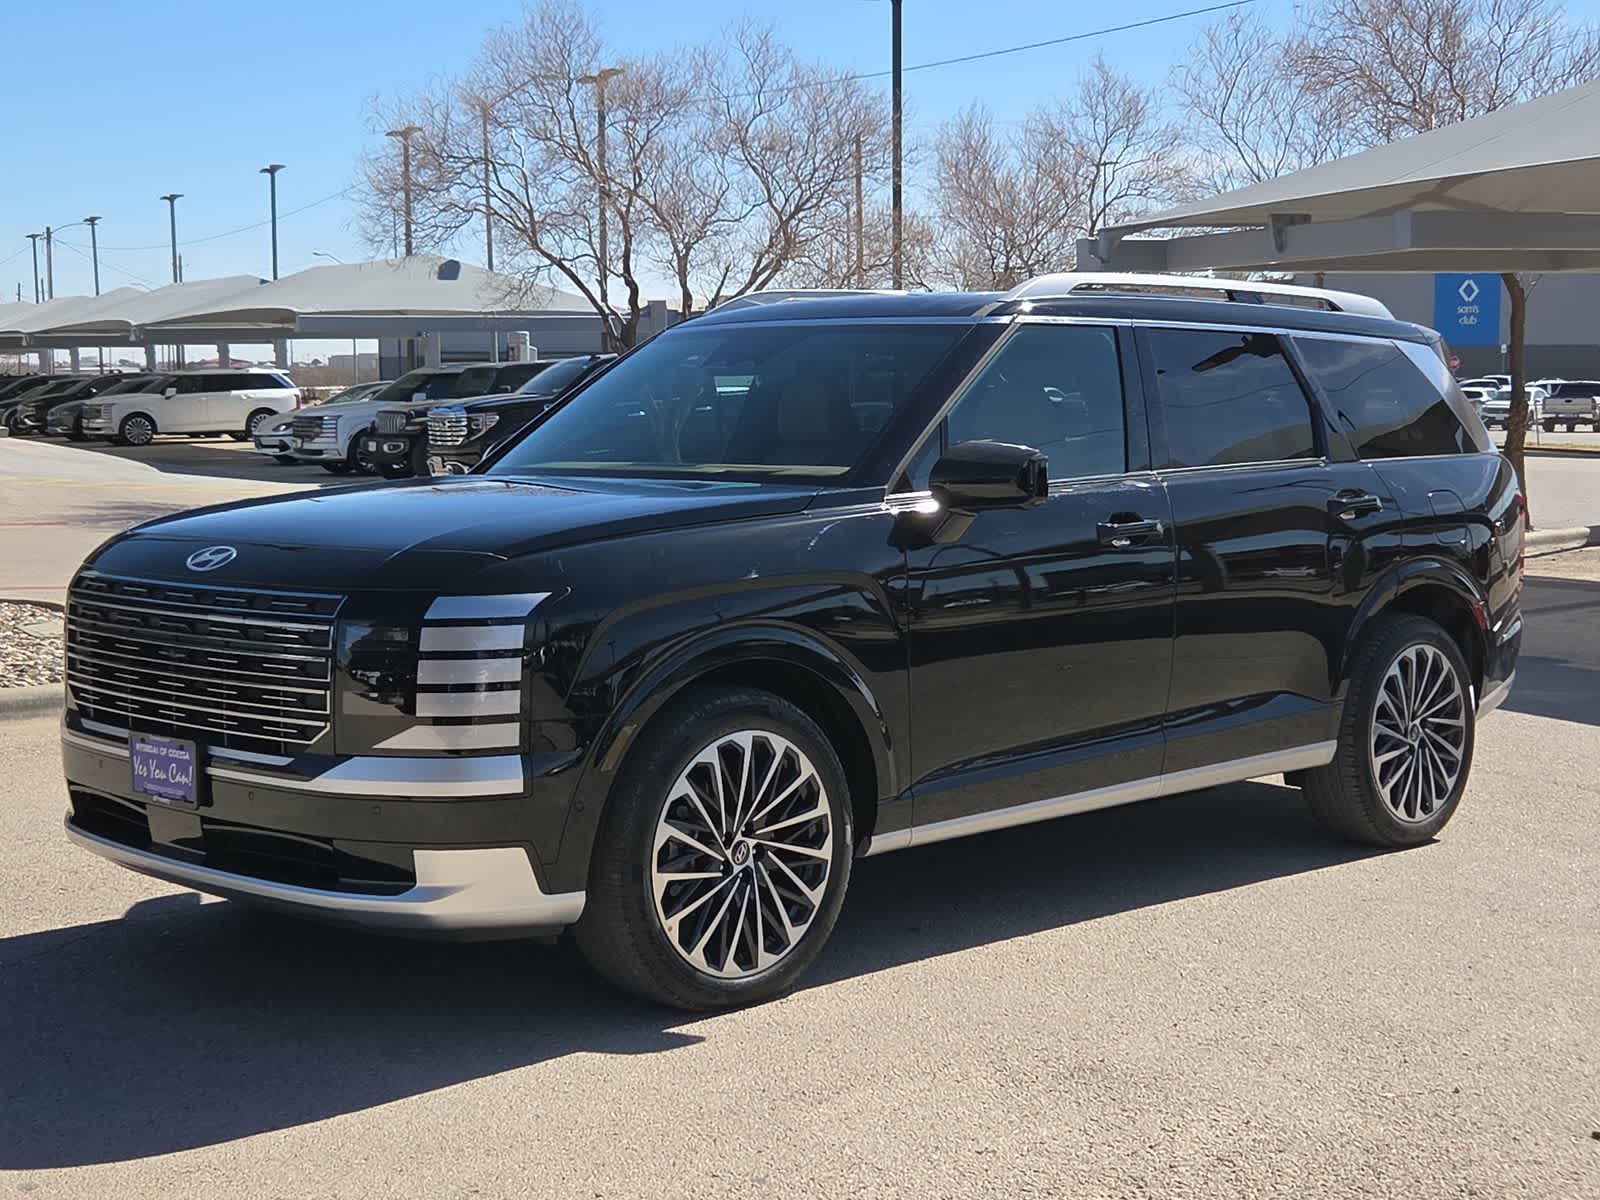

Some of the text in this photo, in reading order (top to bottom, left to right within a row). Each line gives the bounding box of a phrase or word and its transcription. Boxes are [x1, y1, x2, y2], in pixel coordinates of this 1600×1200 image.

[1458, 315, 1478, 324] club
[133, 755, 193, 786] Yes You Can!
